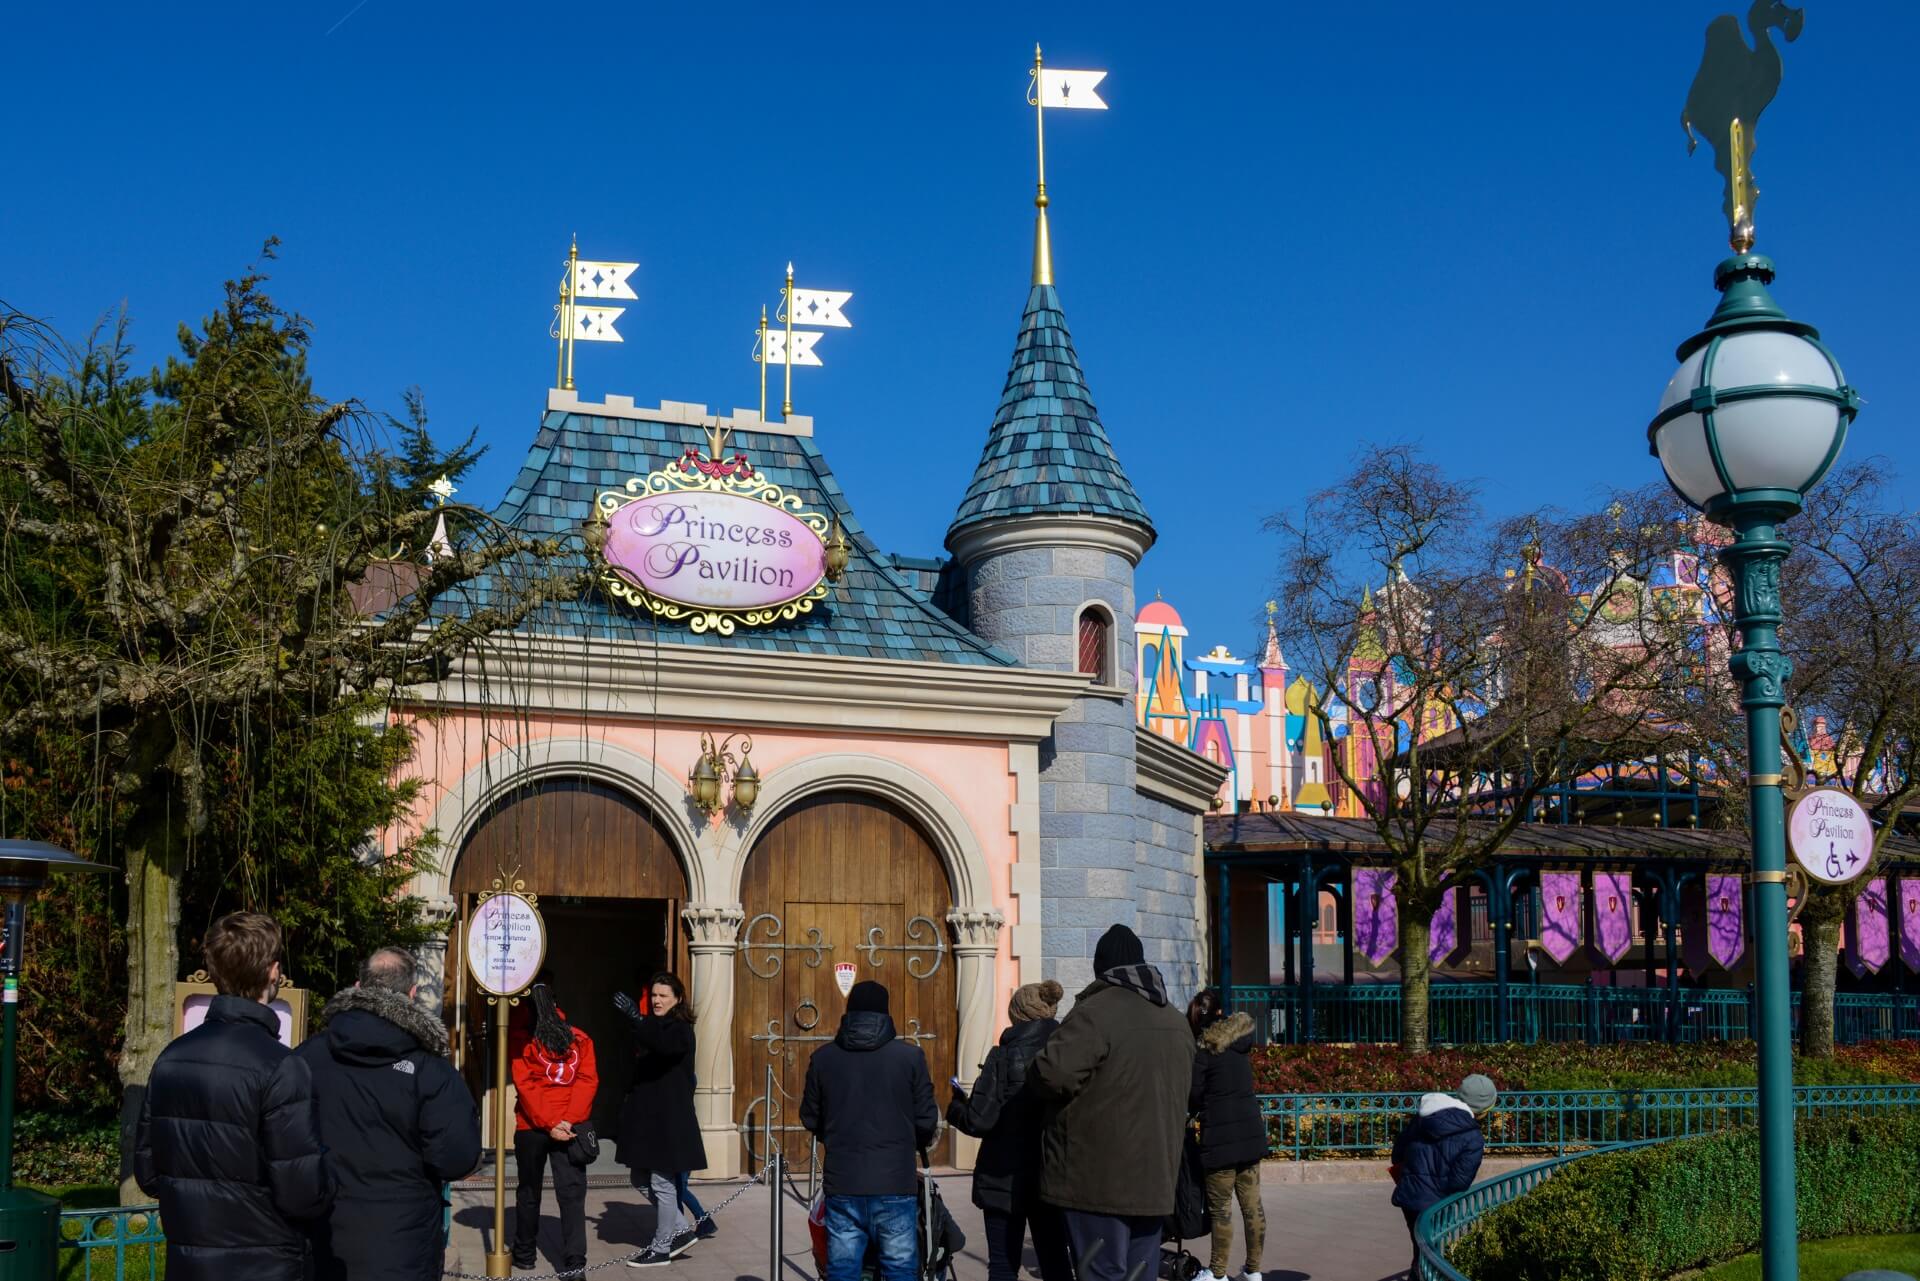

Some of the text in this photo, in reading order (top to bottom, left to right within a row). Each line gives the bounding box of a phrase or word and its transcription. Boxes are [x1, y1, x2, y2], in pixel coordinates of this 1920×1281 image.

[630, 503, 793, 548] Princess
[644, 541, 794, 588] Pavilion
[1807, 796, 1854, 819] Princess
[1809, 818, 1854, 839] Pavilion
[485, 907, 531, 920] Princess
[487, 919, 531, 931] Pavilion
